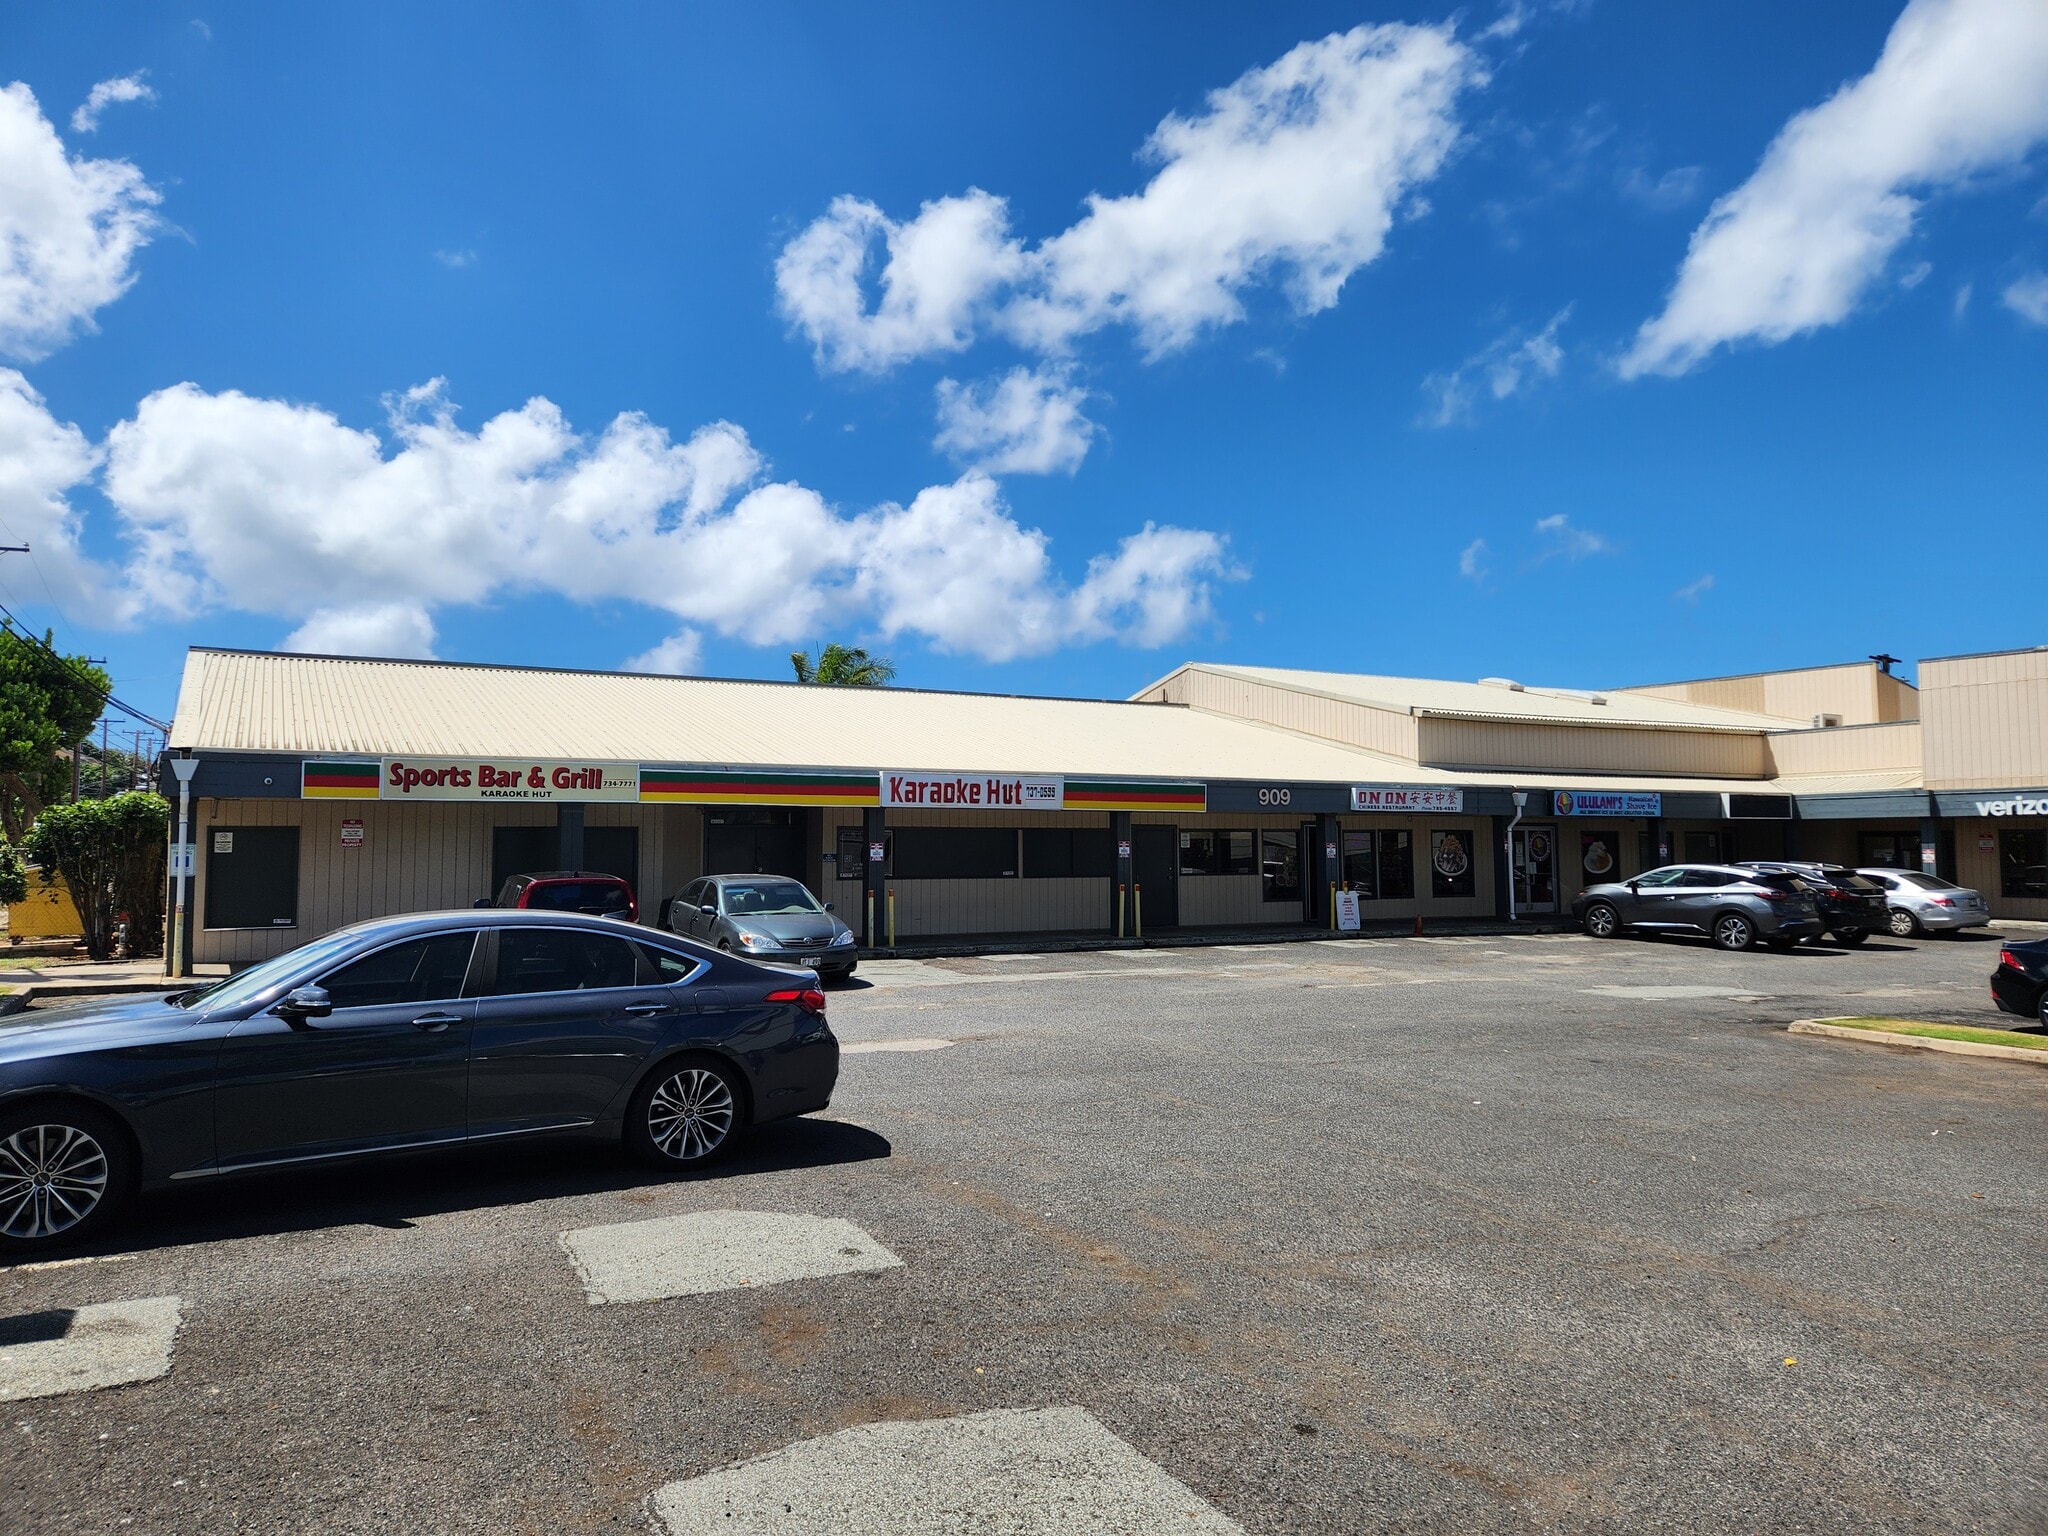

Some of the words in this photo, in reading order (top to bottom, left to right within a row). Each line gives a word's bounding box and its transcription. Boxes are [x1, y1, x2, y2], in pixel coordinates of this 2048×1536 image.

[389, 762, 472, 793] Sports
[478, 765, 522, 788] Bar
[527, 766, 546, 789] &
[552, 767, 603, 790] Grill
[603, 779, 636, 787] 734-7771
[481, 790, 529, 798] KARAOKE
[531, 790, 552, 798] HUT
[889, 776, 981, 804] Karaoke
[986, 779, 1022, 805] Hut
[1259, 789, 1291, 806] 909
[1358, 791, 1381, 804] ON
[1385, 792, 1407, 805] ON
[1410, 791, 1458, 805] 安安中餐
[1577, 795, 1623, 809] ULULANI'S
[1626, 802, 1646, 810] Shave
